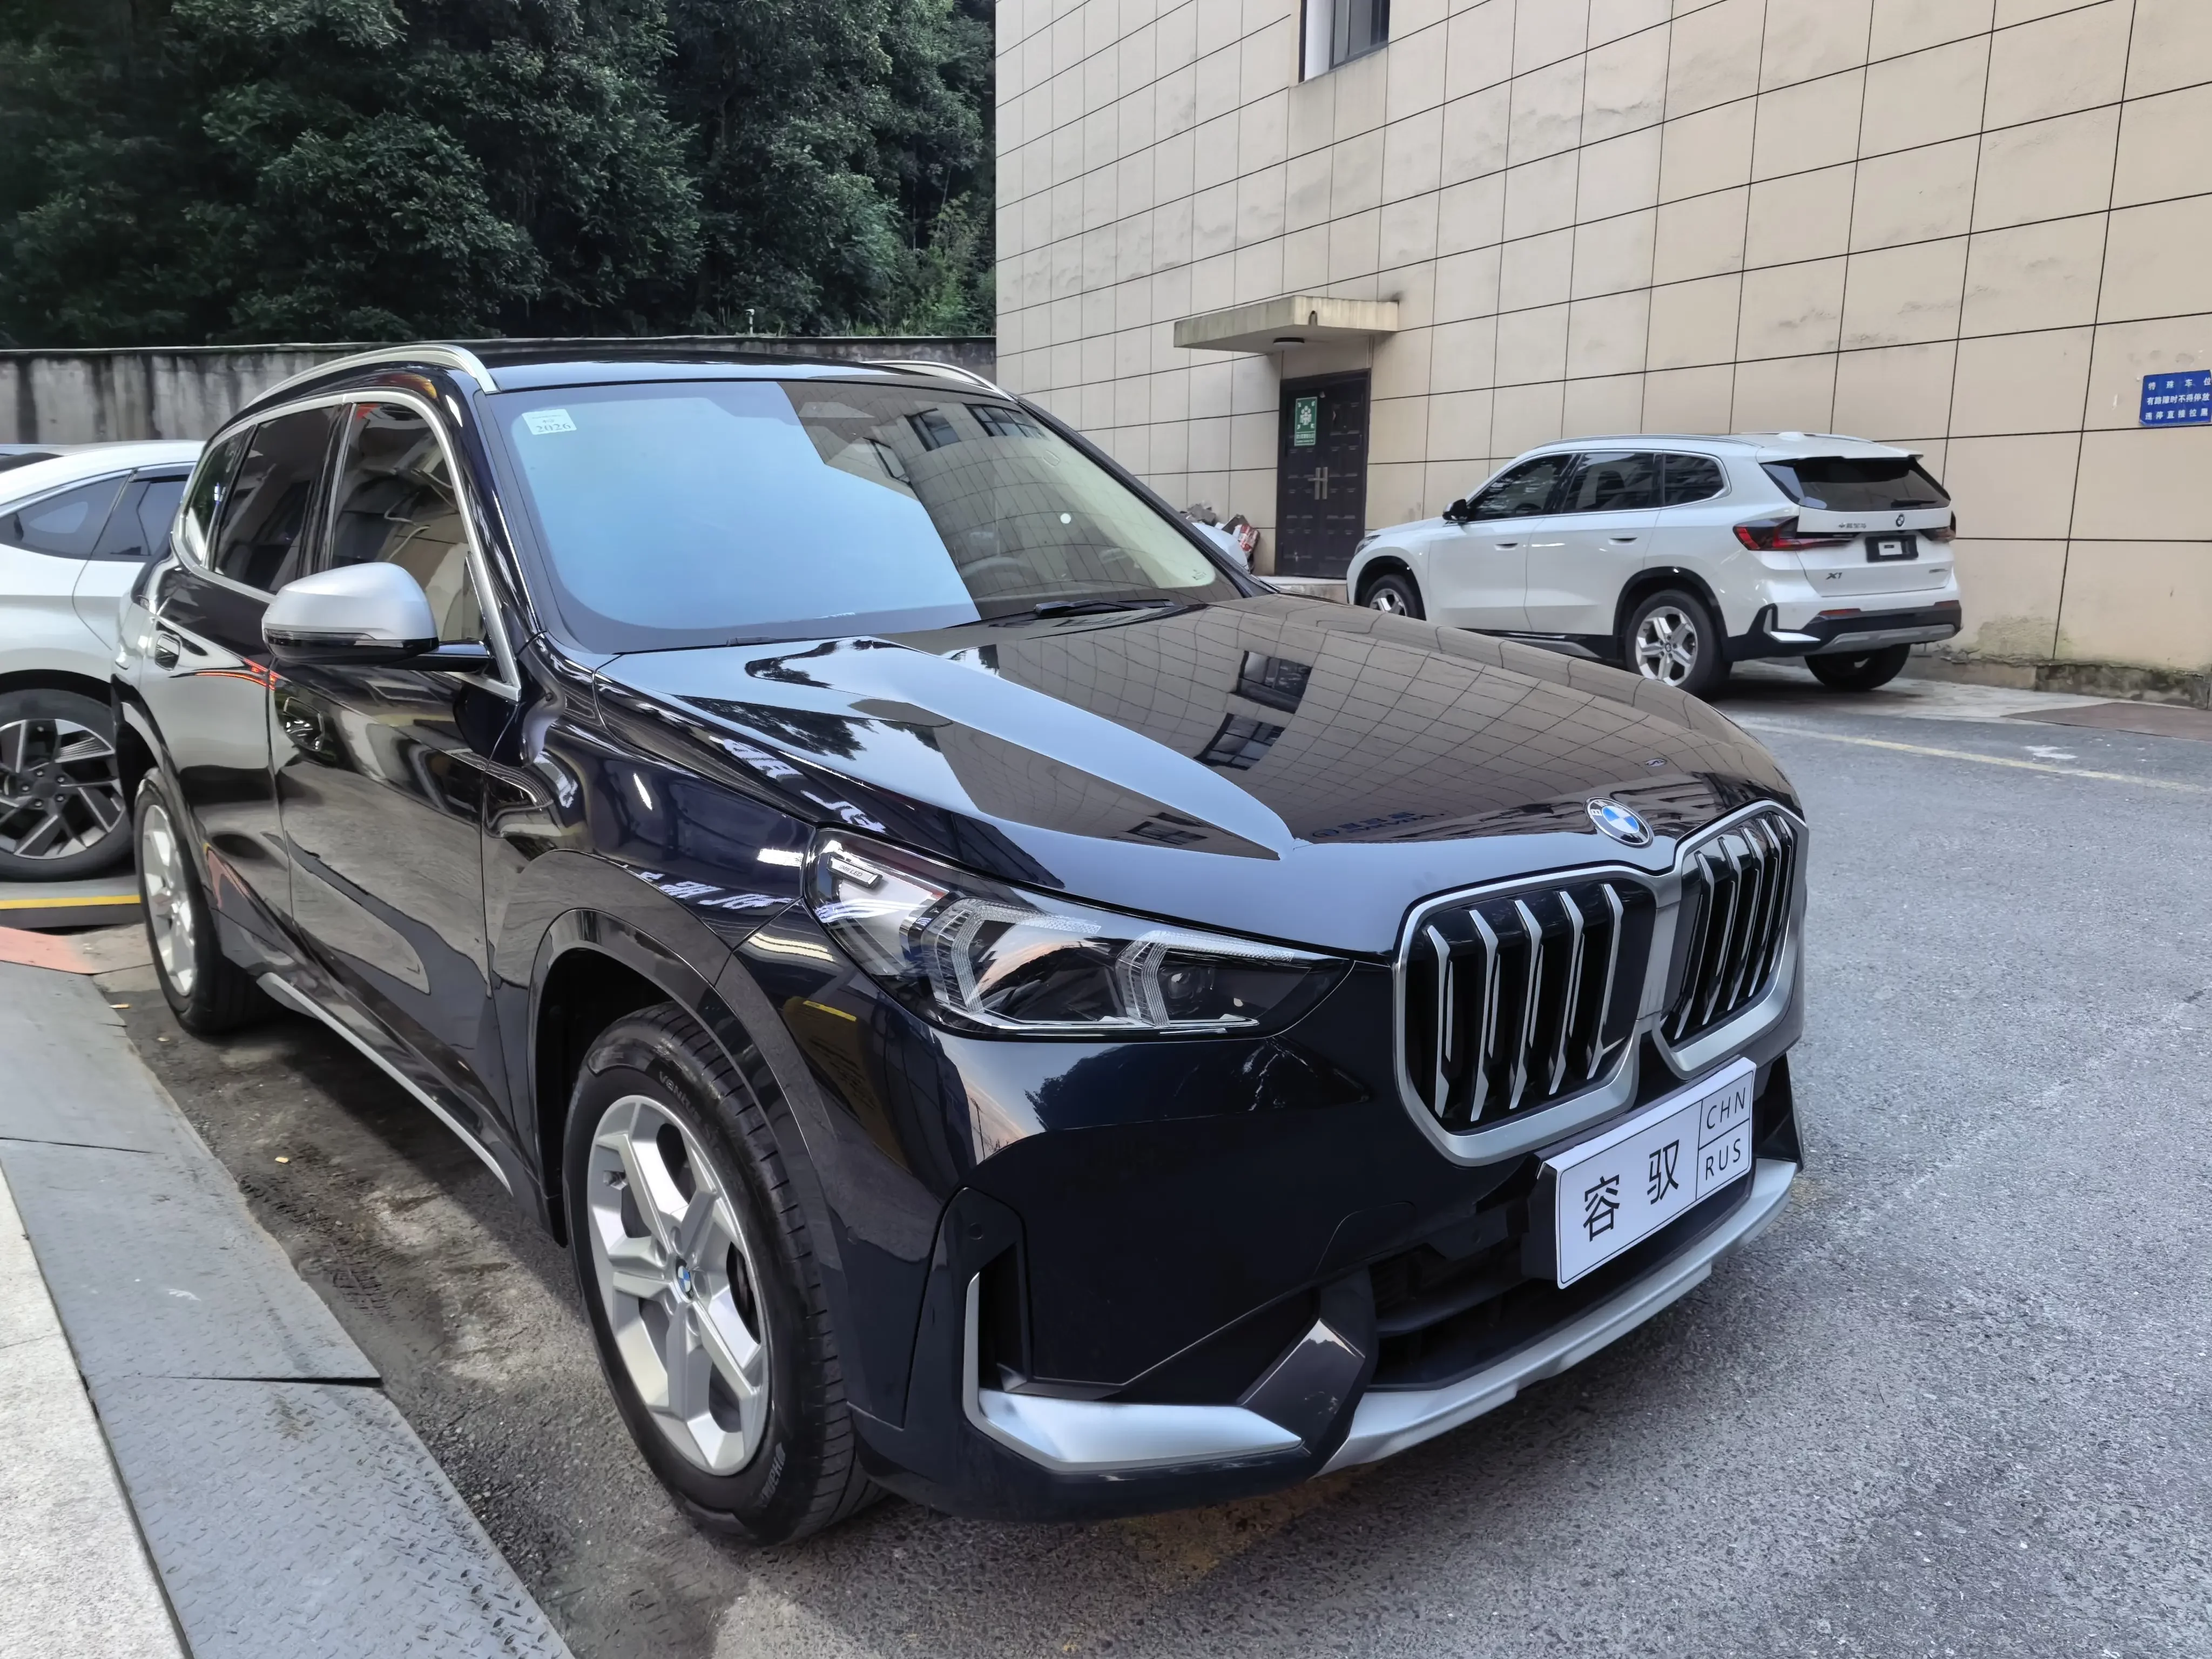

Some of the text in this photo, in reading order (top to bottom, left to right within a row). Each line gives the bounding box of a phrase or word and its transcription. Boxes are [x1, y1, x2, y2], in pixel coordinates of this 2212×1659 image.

[2148, 377, 2211, 390] 特殊车位
[536, 423, 571, 432] 2026
[1826, 572, 1842, 580] X1
[1707, 1087, 1746, 1129] CHN
[1705, 1138, 1741, 1181] RUS
[1583, 1139, 1680, 1242] 容驭
